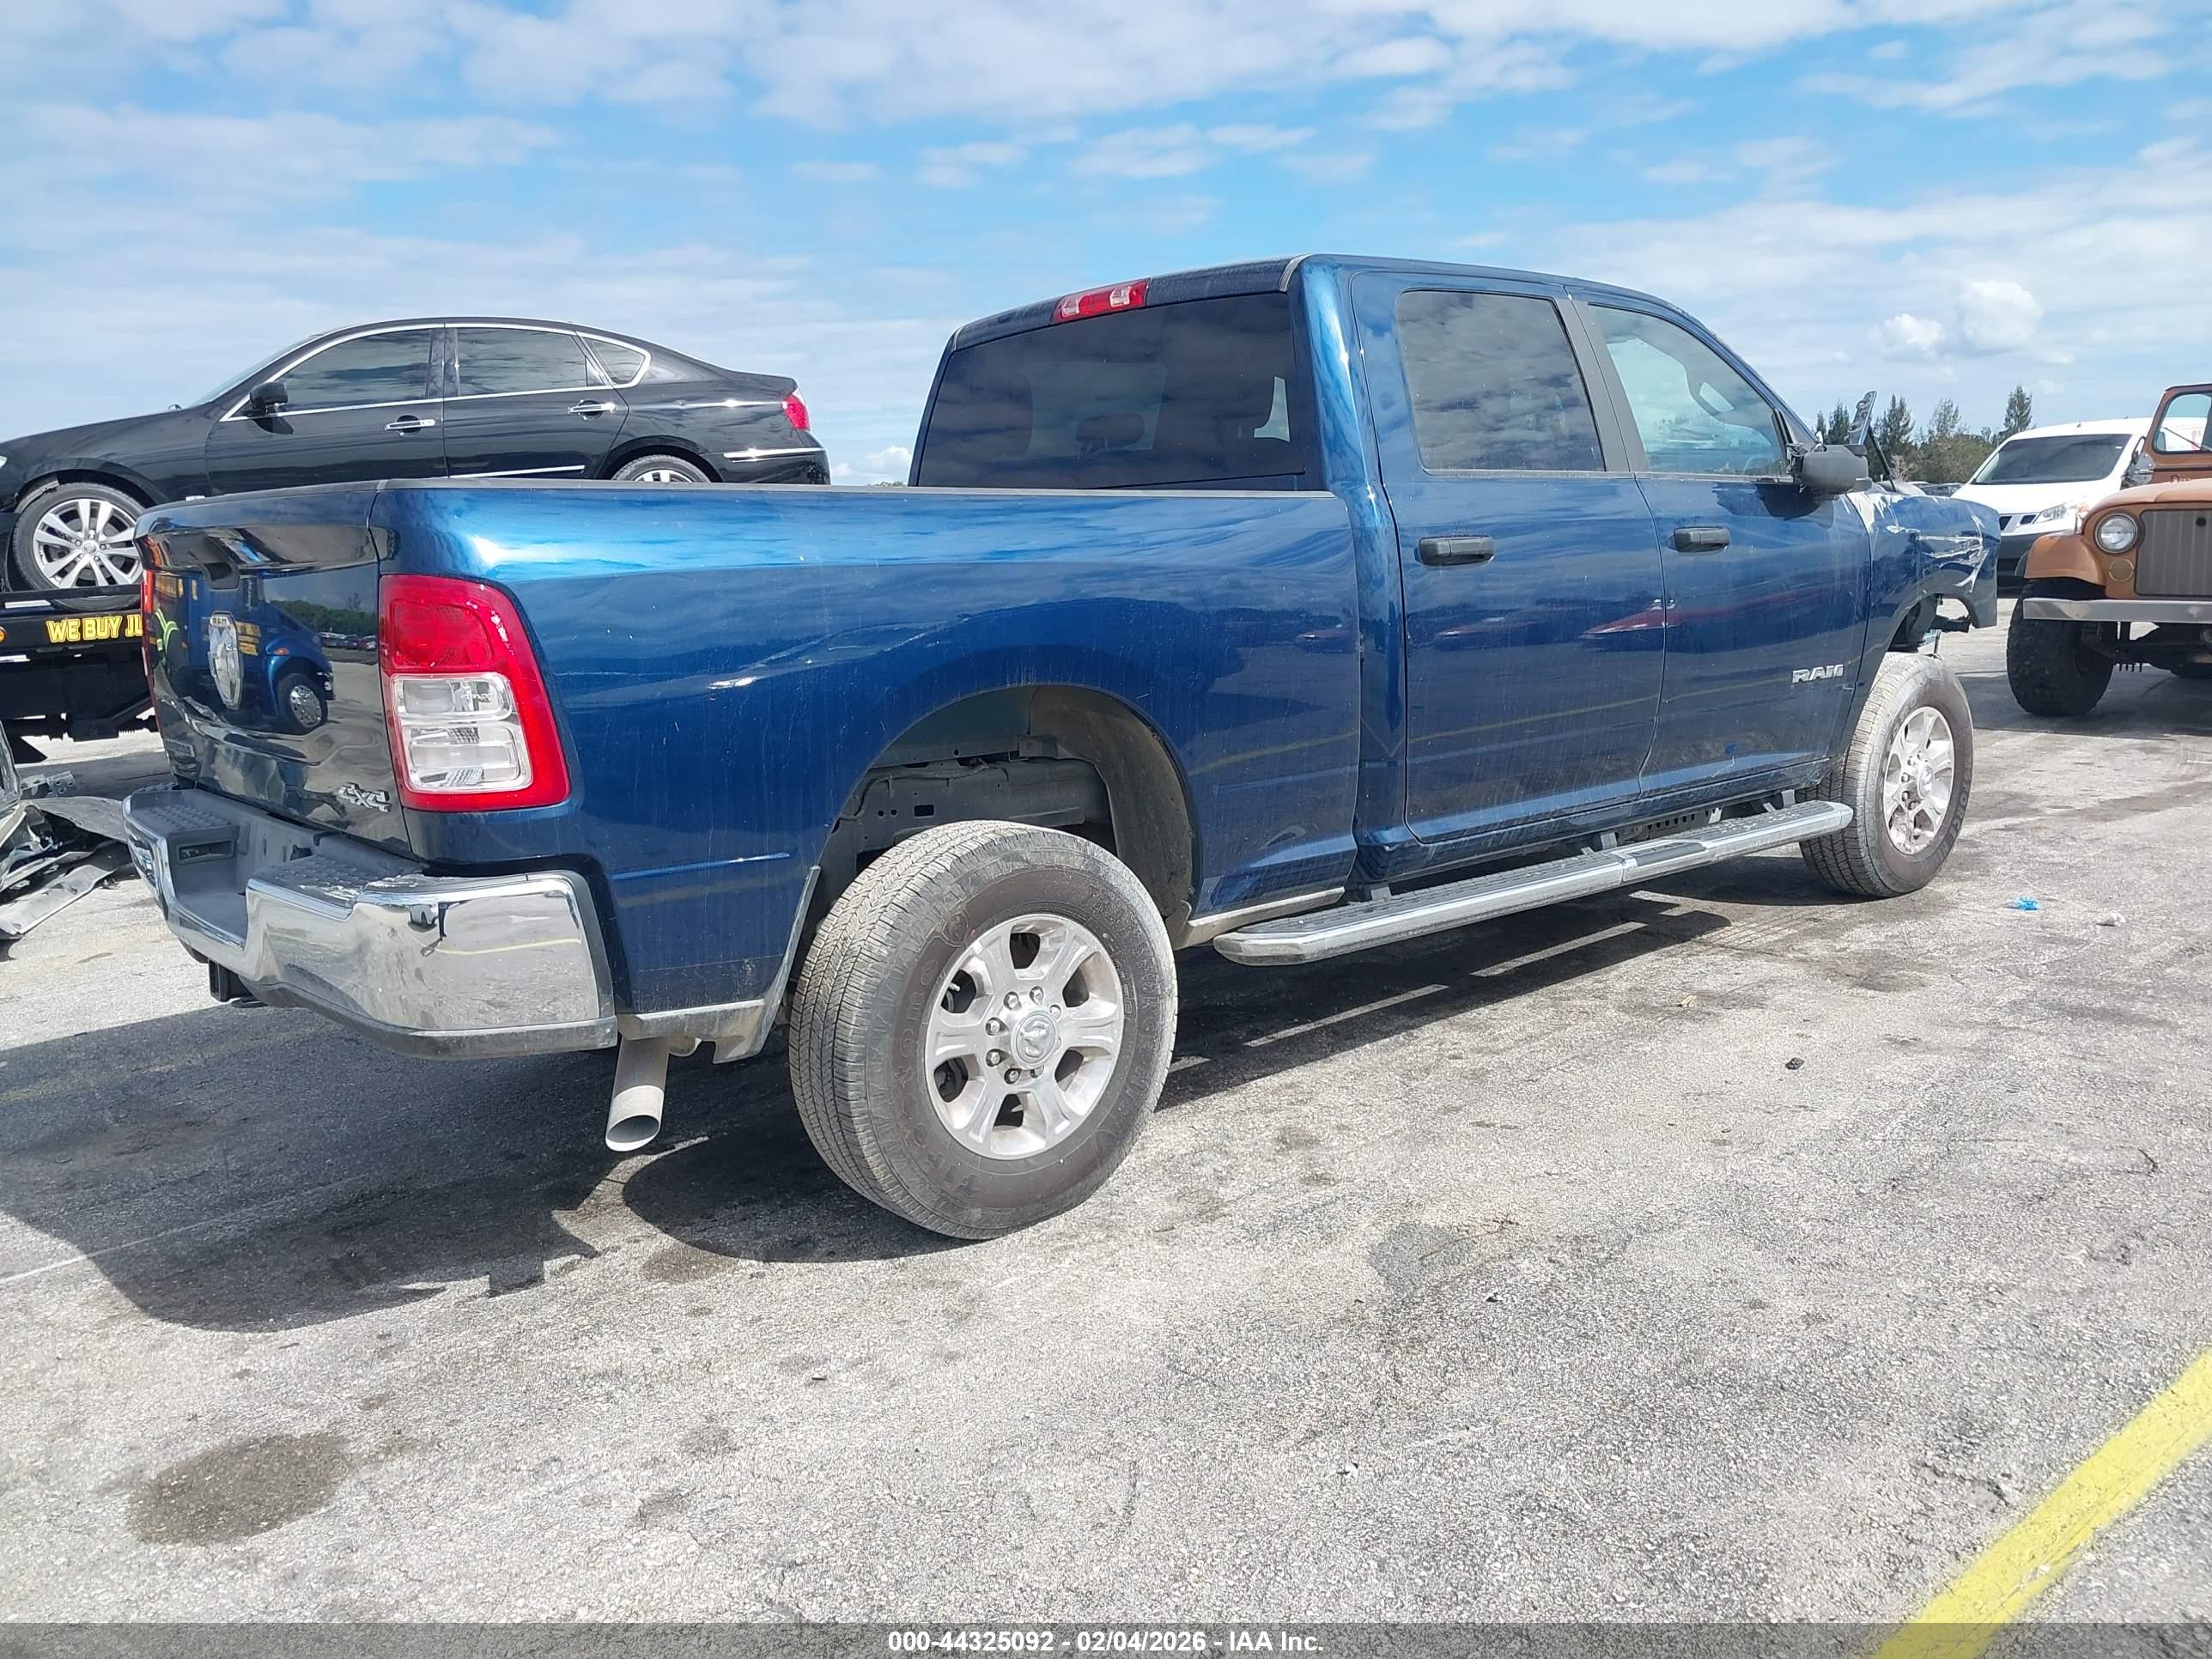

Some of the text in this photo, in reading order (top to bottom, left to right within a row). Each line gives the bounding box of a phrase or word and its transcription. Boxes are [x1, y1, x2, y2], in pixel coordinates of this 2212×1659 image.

[46, 619, 81, 643] WE
[82, 616, 123, 641] BUY
[1791, 664, 1844, 684] RAM
